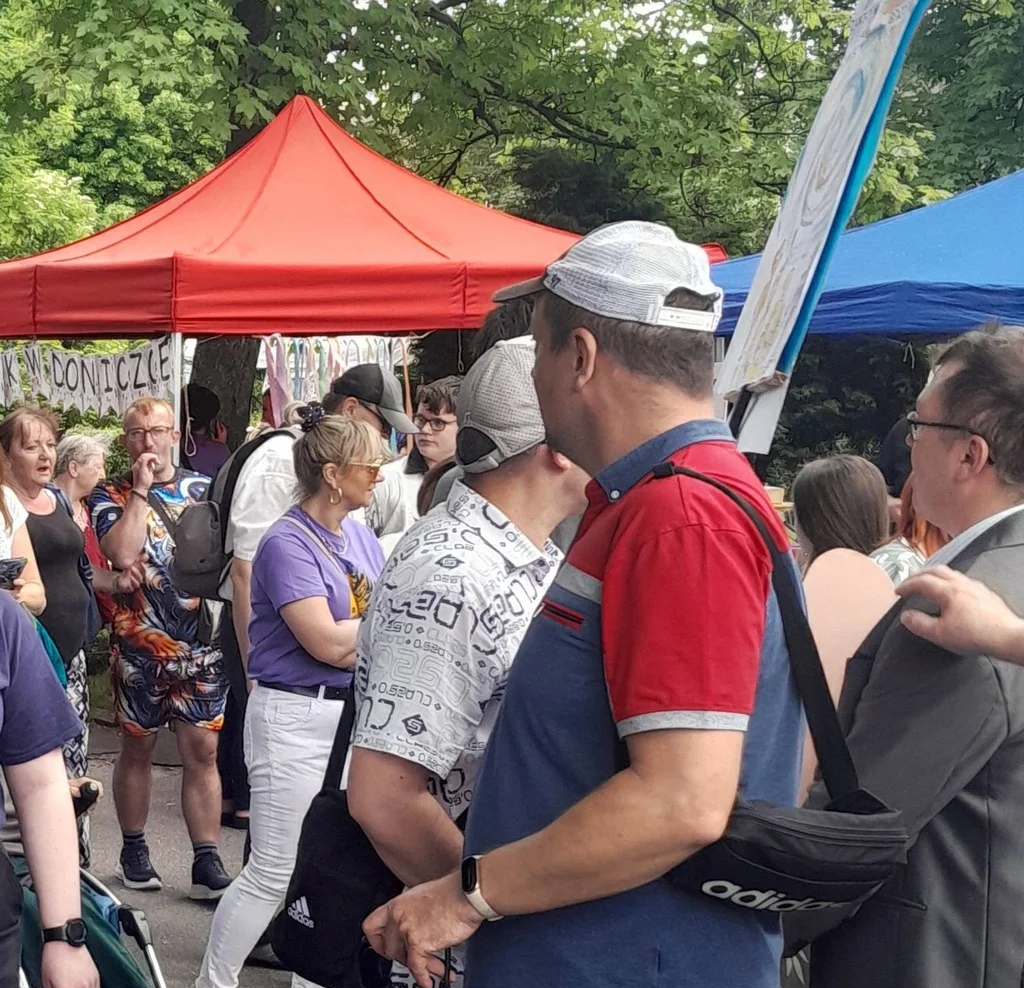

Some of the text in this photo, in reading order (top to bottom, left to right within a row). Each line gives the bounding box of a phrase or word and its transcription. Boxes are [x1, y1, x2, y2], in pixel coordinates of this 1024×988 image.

[26, 350, 42, 375] W
[52, 336, 171, 393] DONICZCE
[287, 906, 314, 928] adidas
